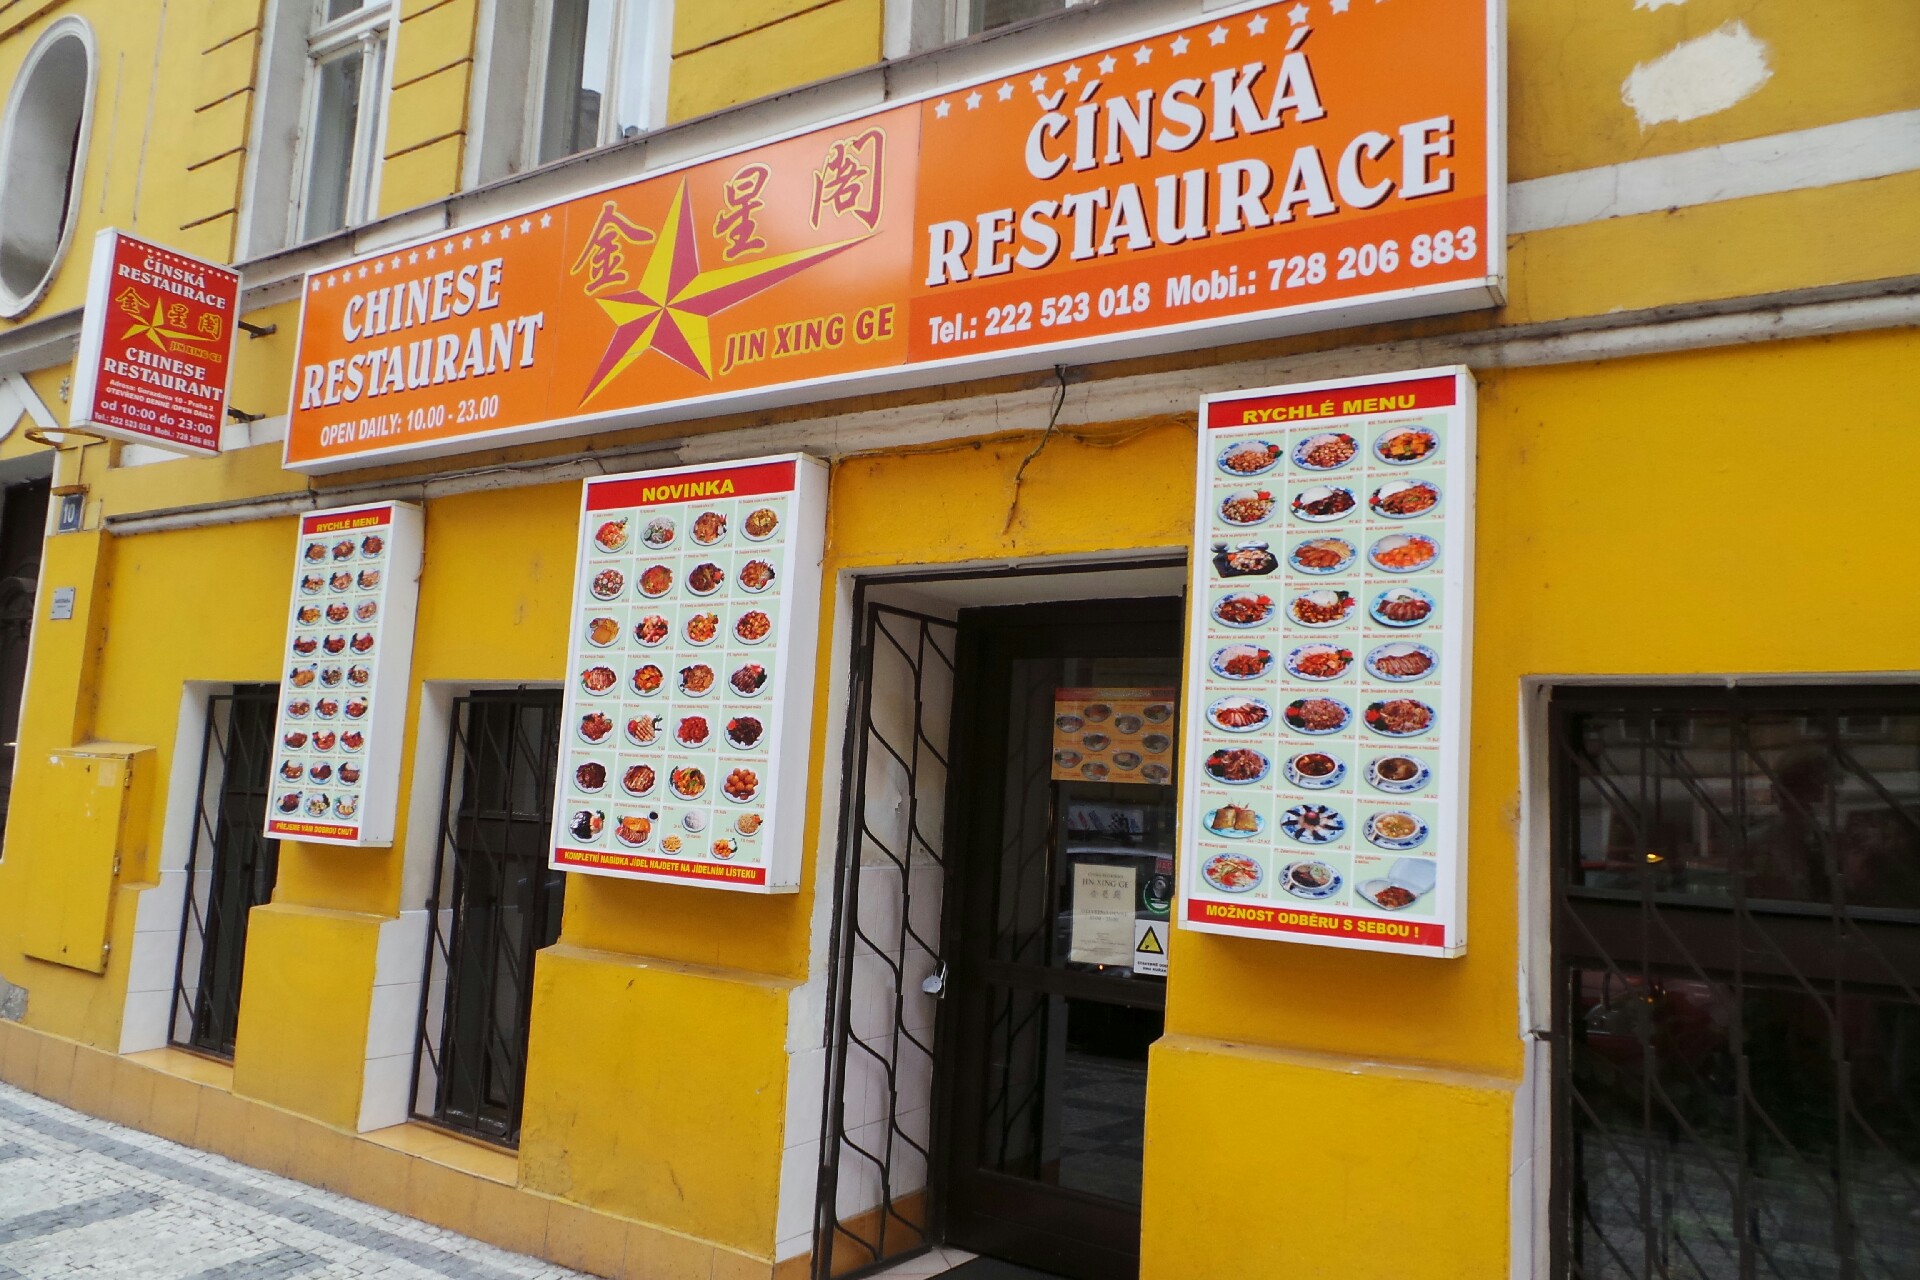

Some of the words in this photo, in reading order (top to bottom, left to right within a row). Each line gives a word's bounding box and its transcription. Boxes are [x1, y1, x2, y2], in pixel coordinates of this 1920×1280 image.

[1023, 25, 1327, 182] ČÍNSKÁ
[925, 114, 1457, 289] RESTAURACE
[118, 263, 226, 309] RESTAURACE
[143, 257, 206, 288] ČÍNSKÁ
[929, 315, 977, 346] Tel.:
[985, 301, 1032, 338] 222
[1039, 290, 1089, 327] 523
[1098, 282, 1150, 318] 018
[1165, 268, 1256, 310] Mobi.:
[1267, 253, 1326, 292] 728
[1337, 239, 1399, 282] 206
[1410, 226, 1478, 270] 883
[342, 258, 503, 343] CHINESE
[170, 341, 184, 352] JIN
[719, 328, 767, 376] JIN
[773, 315, 844, 359] XING
[853, 303, 895, 345] GE
[126, 347, 206, 380] CHINESE
[300, 312, 544, 410] RESTAURANT
[103, 358, 224, 401] RESTAURANT
[100, 400, 118, 411] od
[121, 404, 156, 420] 10:00
[159, 413, 175, 425] do
[178, 417, 213, 434] 23:00
[188, 400, 208, 411] Praha
[320, 420, 355, 447] OPEN
[359, 412, 402, 440] DAILY:
[407, 404, 444, 431] 10.00
[457, 395, 499, 424] 23.00
[1242, 400, 1334, 424] RYCHLÉ
[1343, 394, 1416, 415] MENU
[642, 479, 735, 502] NOVINKA
[62, 503, 76, 524] 10
[316, 518, 350, 532] RYCHLÉ
[353, 516, 379, 528] MENU
[564, 851, 600, 863] KOMPLETNÍ
[600, 854, 629, 866] NABÍDKA
[629, 857, 648, 868] JÍDEL
[649, 859, 680, 871] NAJDETE
[680, 863, 690, 873] NA
[691, 864, 725, 876] JÍDELNÍM
[1206, 902, 1274, 924] MOŽNOST
[1278, 910, 1339, 930] ODBĚRU
[1343, 920, 1353, 931] S
[1357, 920, 1410, 937] SEBOU
